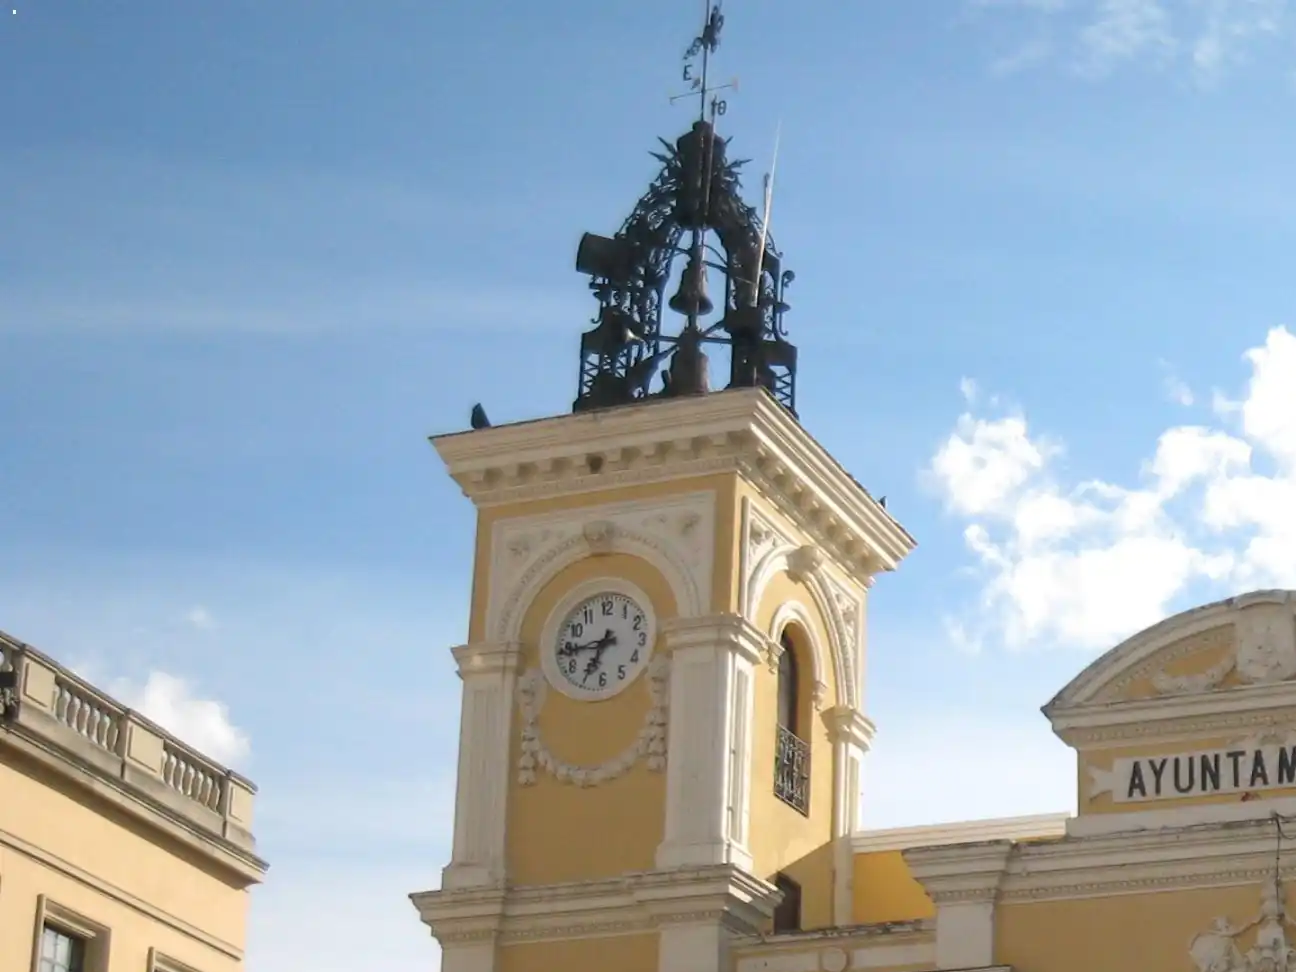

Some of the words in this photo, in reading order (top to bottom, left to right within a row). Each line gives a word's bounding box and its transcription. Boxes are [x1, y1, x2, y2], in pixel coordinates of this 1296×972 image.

[602, 601, 614, 616] 12
[621, 605, 628, 619] 1
[584, 609, 594, 624] 11
[633, 615, 642, 630] 2
[571, 623, 583, 638] 10
[638, 632, 647, 646] 3
[630, 649, 638, 663] 4
[569, 659, 577, 674] 8
[618, 665, 626, 680] 5
[599, 672, 607, 687] 6
